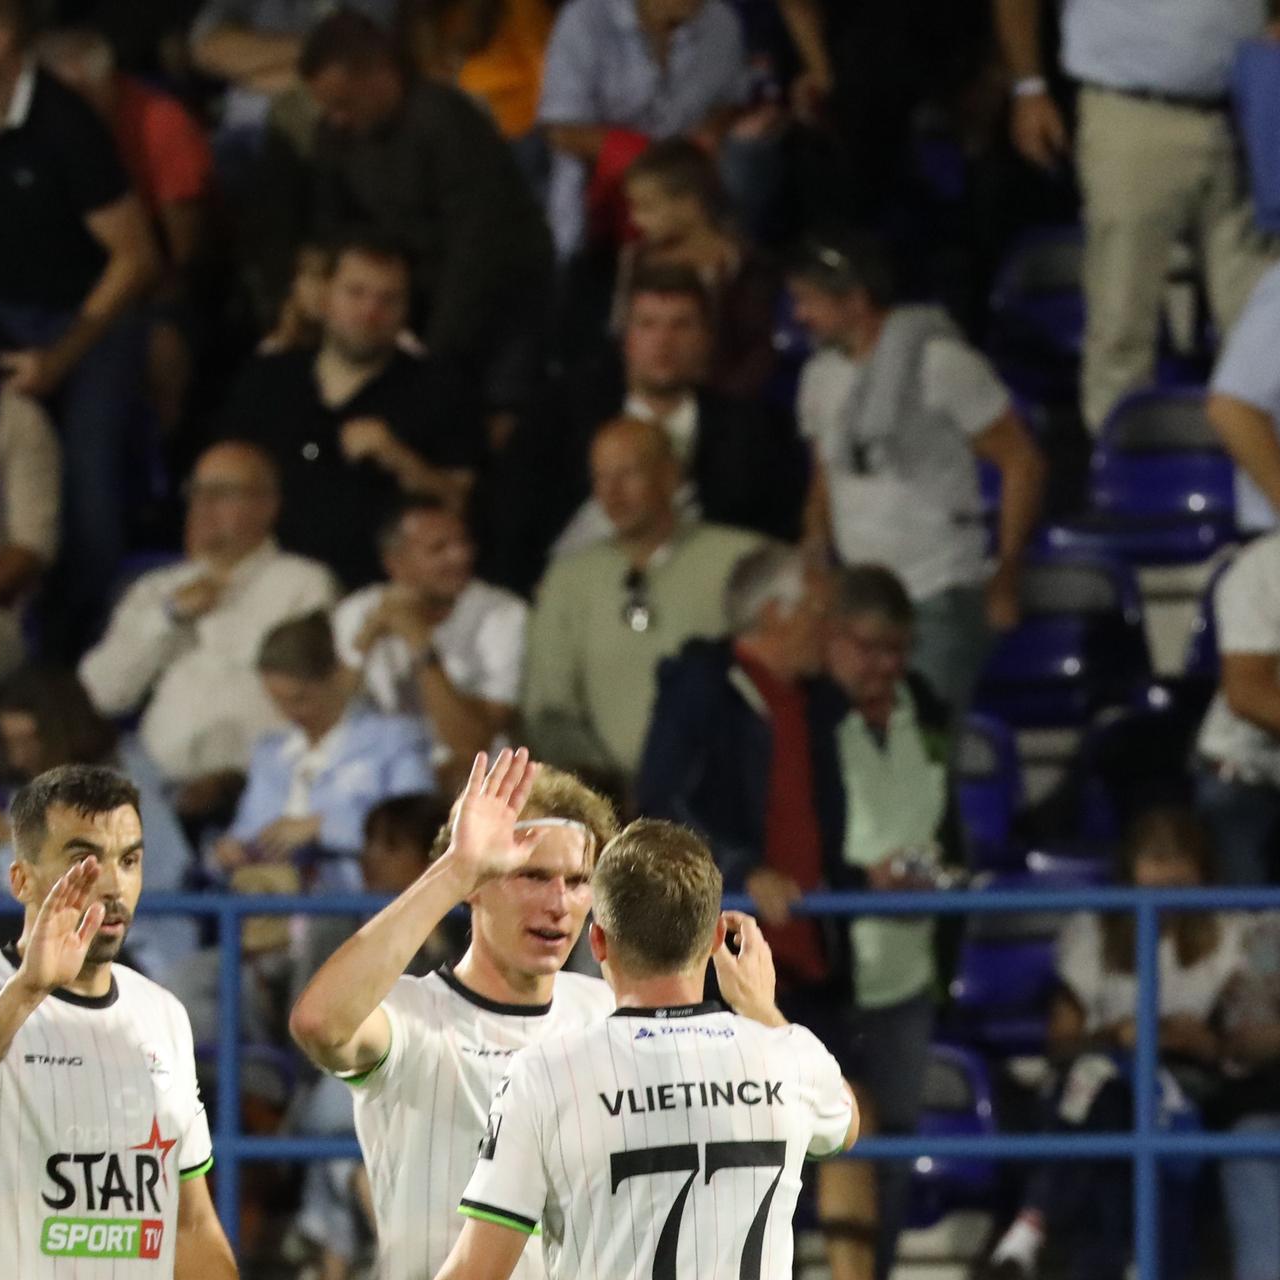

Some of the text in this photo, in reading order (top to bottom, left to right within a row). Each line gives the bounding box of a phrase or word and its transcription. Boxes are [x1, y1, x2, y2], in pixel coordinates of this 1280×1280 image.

[599, 1080, 784, 1116] VLIETINCK
[42, 1151, 162, 1213] STAR
[46, 1223, 162, 1252] SPORT TV
